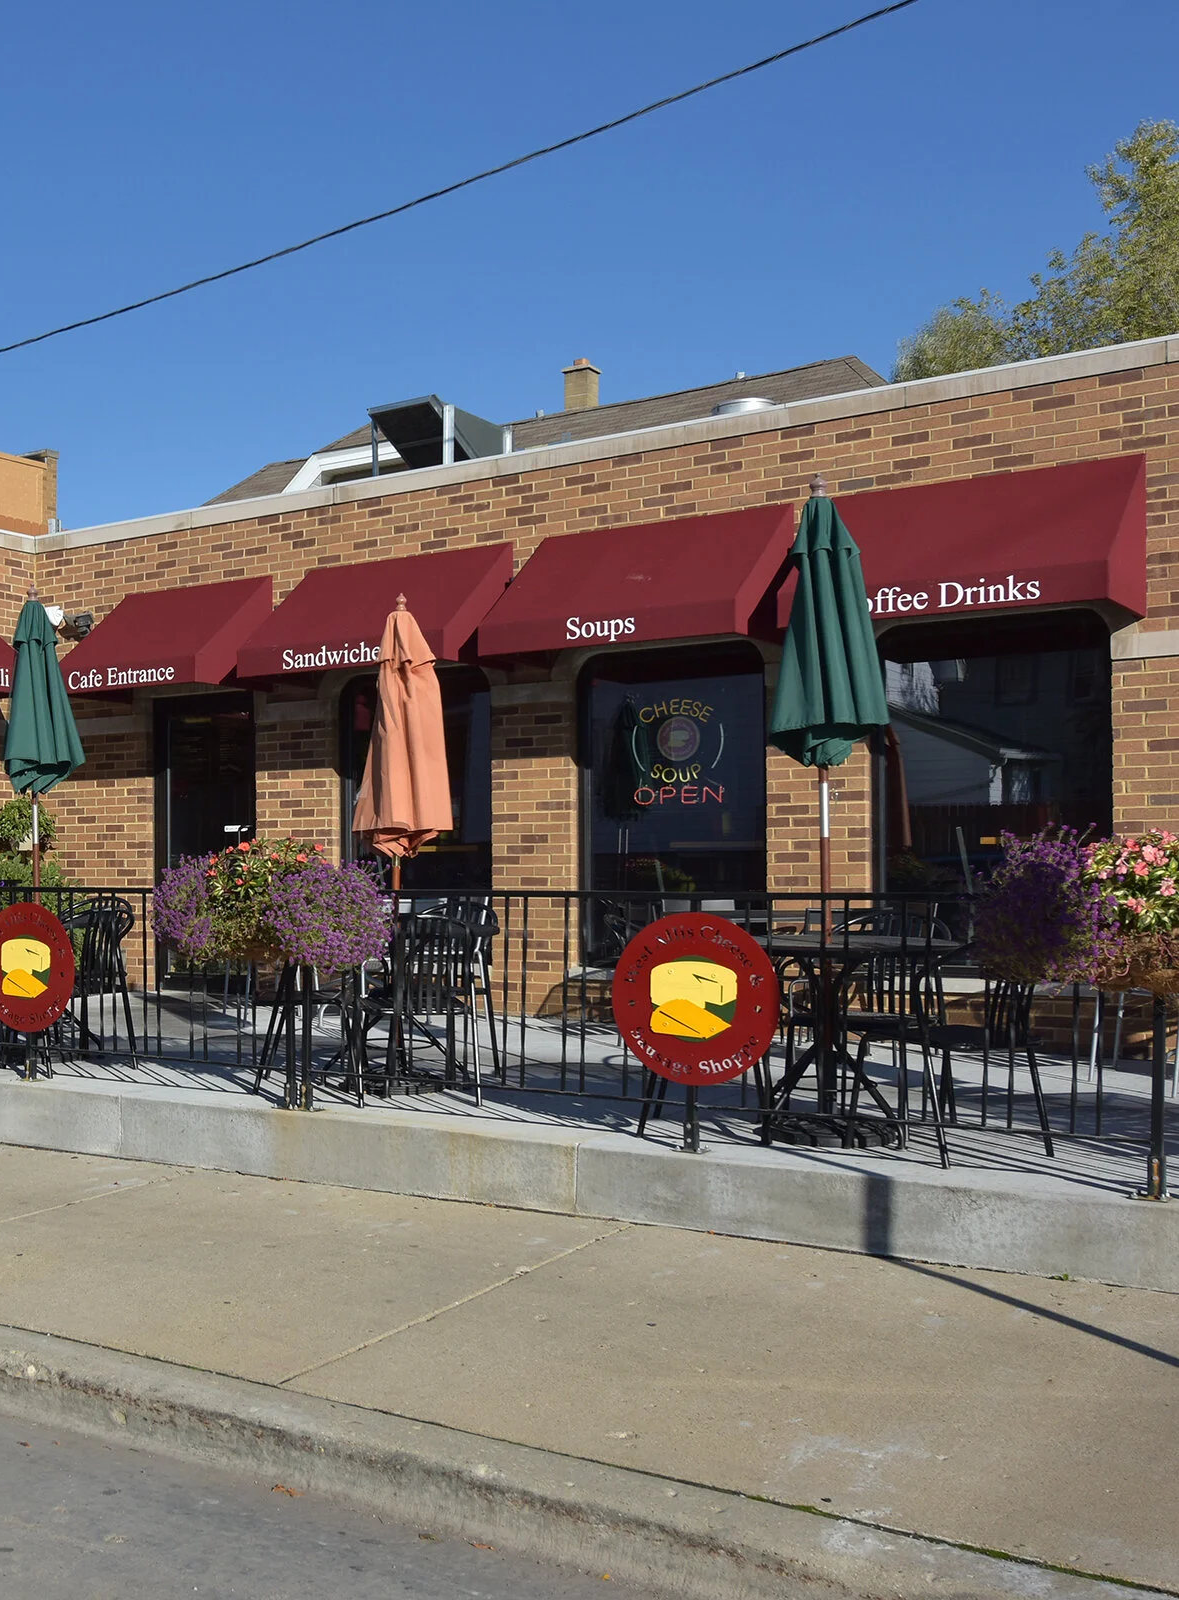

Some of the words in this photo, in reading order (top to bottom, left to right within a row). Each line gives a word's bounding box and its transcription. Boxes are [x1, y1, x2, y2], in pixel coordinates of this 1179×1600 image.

[866, 586, 929, 614] ffee
[937, 574, 1042, 609] Drinks
[566, 615, 636, 642] Soups
[282, 641, 381, 670] Sandwiche
[68, 668, 103, 691] Cafe
[106, 665, 175, 687] Entrance
[639, 698, 714, 723] CHEESE
[650, 763, 702, 783] SOUP
[634, 785, 724, 805] OPEN
[655, 925, 695, 949] Allis
[699, 925, 753, 969] Cheese
[630, 1025, 693, 1077] Sausage
[698, 1035, 760, 1077] Shoppe
